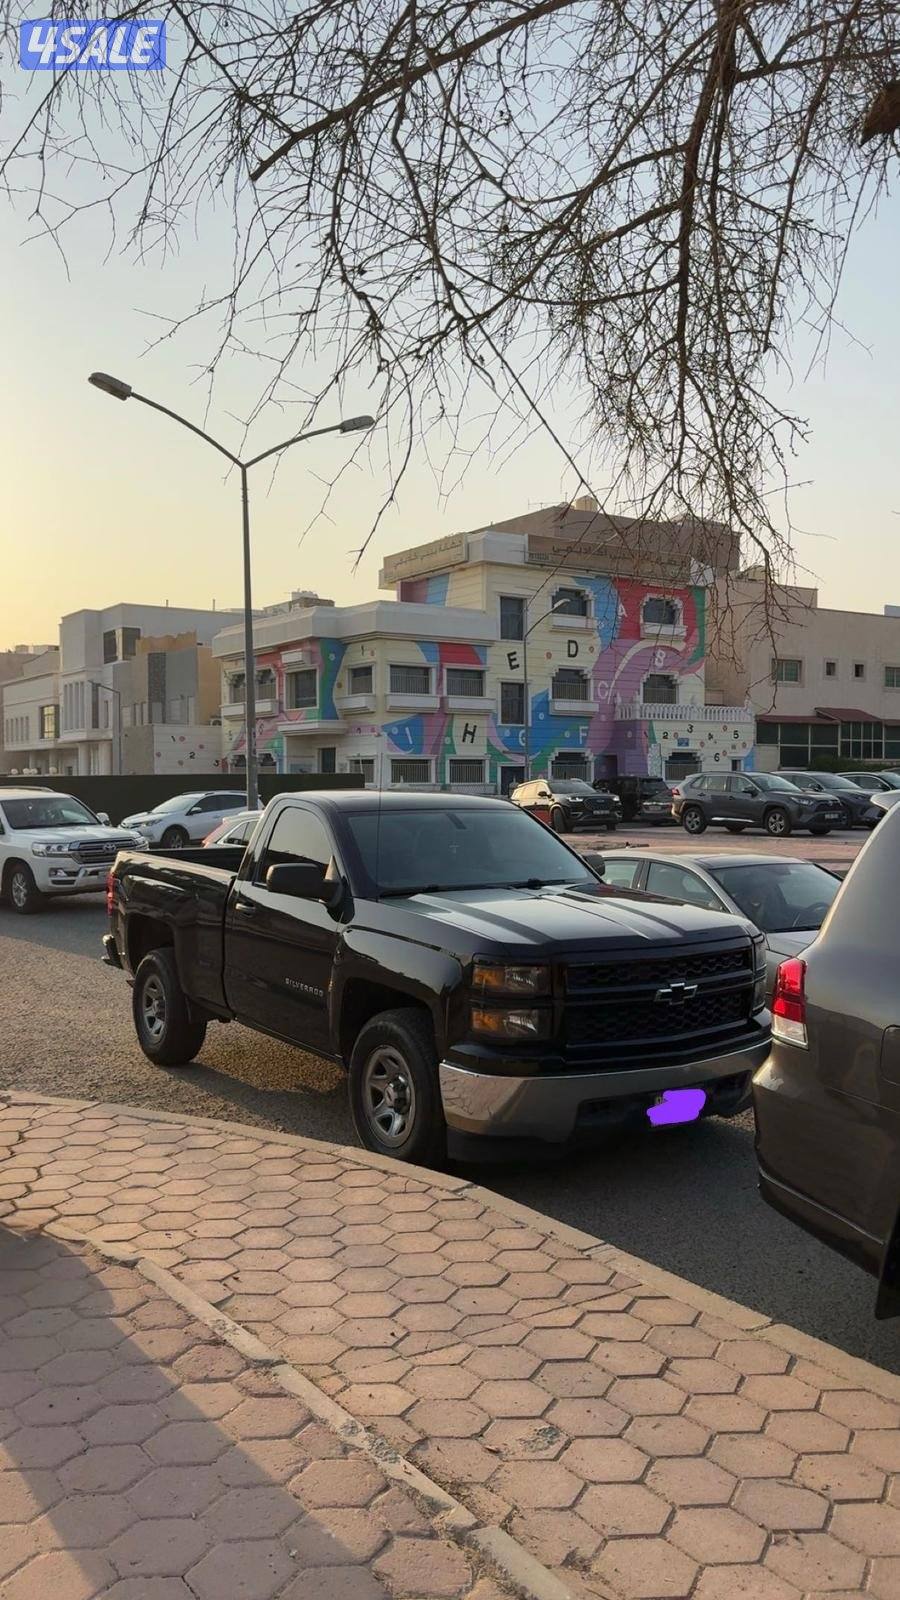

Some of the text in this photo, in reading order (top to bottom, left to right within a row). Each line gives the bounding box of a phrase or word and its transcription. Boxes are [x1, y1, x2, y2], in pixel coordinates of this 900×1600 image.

[567, 639, 579, 658] D
[654, 648, 666, 667] B
[506, 651, 520, 671] E
[597, 680, 609, 700] C
[462, 722, 478, 744] H
[578, 726, 589, 744] F
[662, 731, 669, 740] 2
[687, 724, 694, 734] 3
[733, 730, 740, 739] 5
[189, 751, 196, 760] 2
[713, 752, 720, 762] 6
[285, 977, 324, 998] SILVERADO
